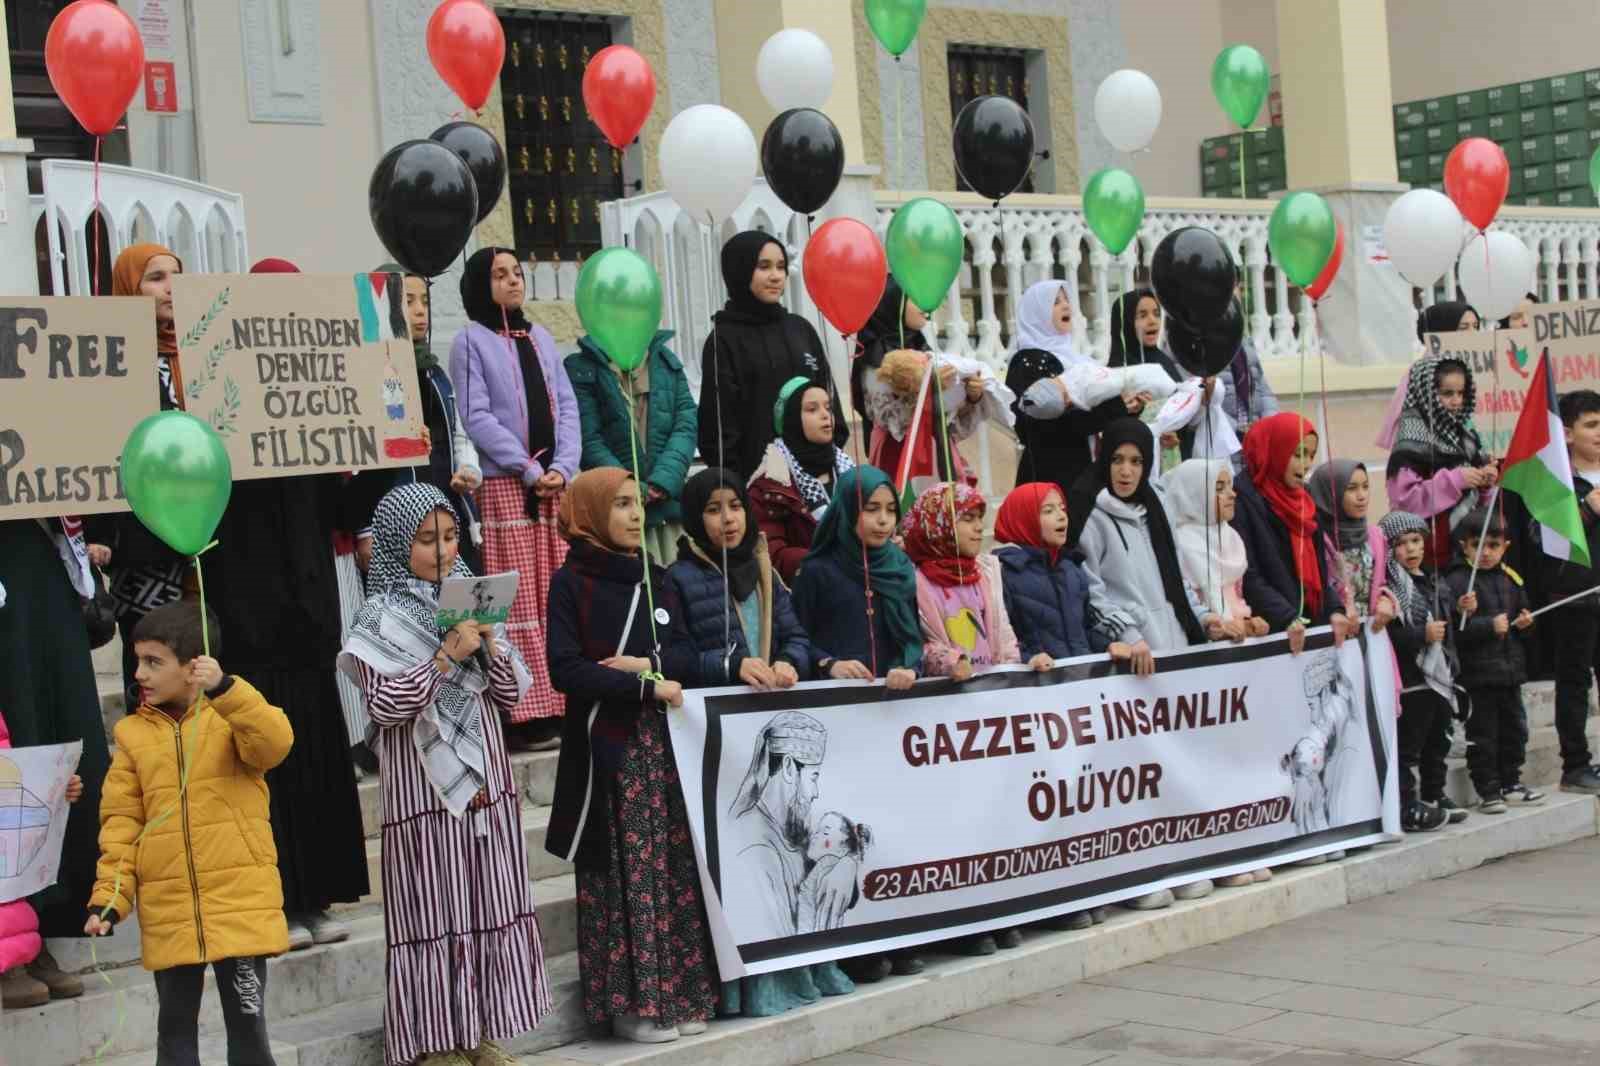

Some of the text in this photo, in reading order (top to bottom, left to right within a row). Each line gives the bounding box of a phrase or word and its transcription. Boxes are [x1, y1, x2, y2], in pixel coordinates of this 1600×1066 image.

[0, 307, 128, 379] FREE
[232, 312, 361, 350] NEHİRDEN
[256, 348, 347, 384] DENİZE
[264, 386, 362, 419] ÖZGÜR
[250, 419, 379, 467] FİLİSTİN
[902, 686, 1249, 767] GAZZE'DE İNSANLIK
[1027, 763, 1163, 822] ÖLÜYOR
[873, 800, 1285, 899] 23 ARALIK DÜNYA ŞEHİD ÇOCUKLAR GÜNÜ
